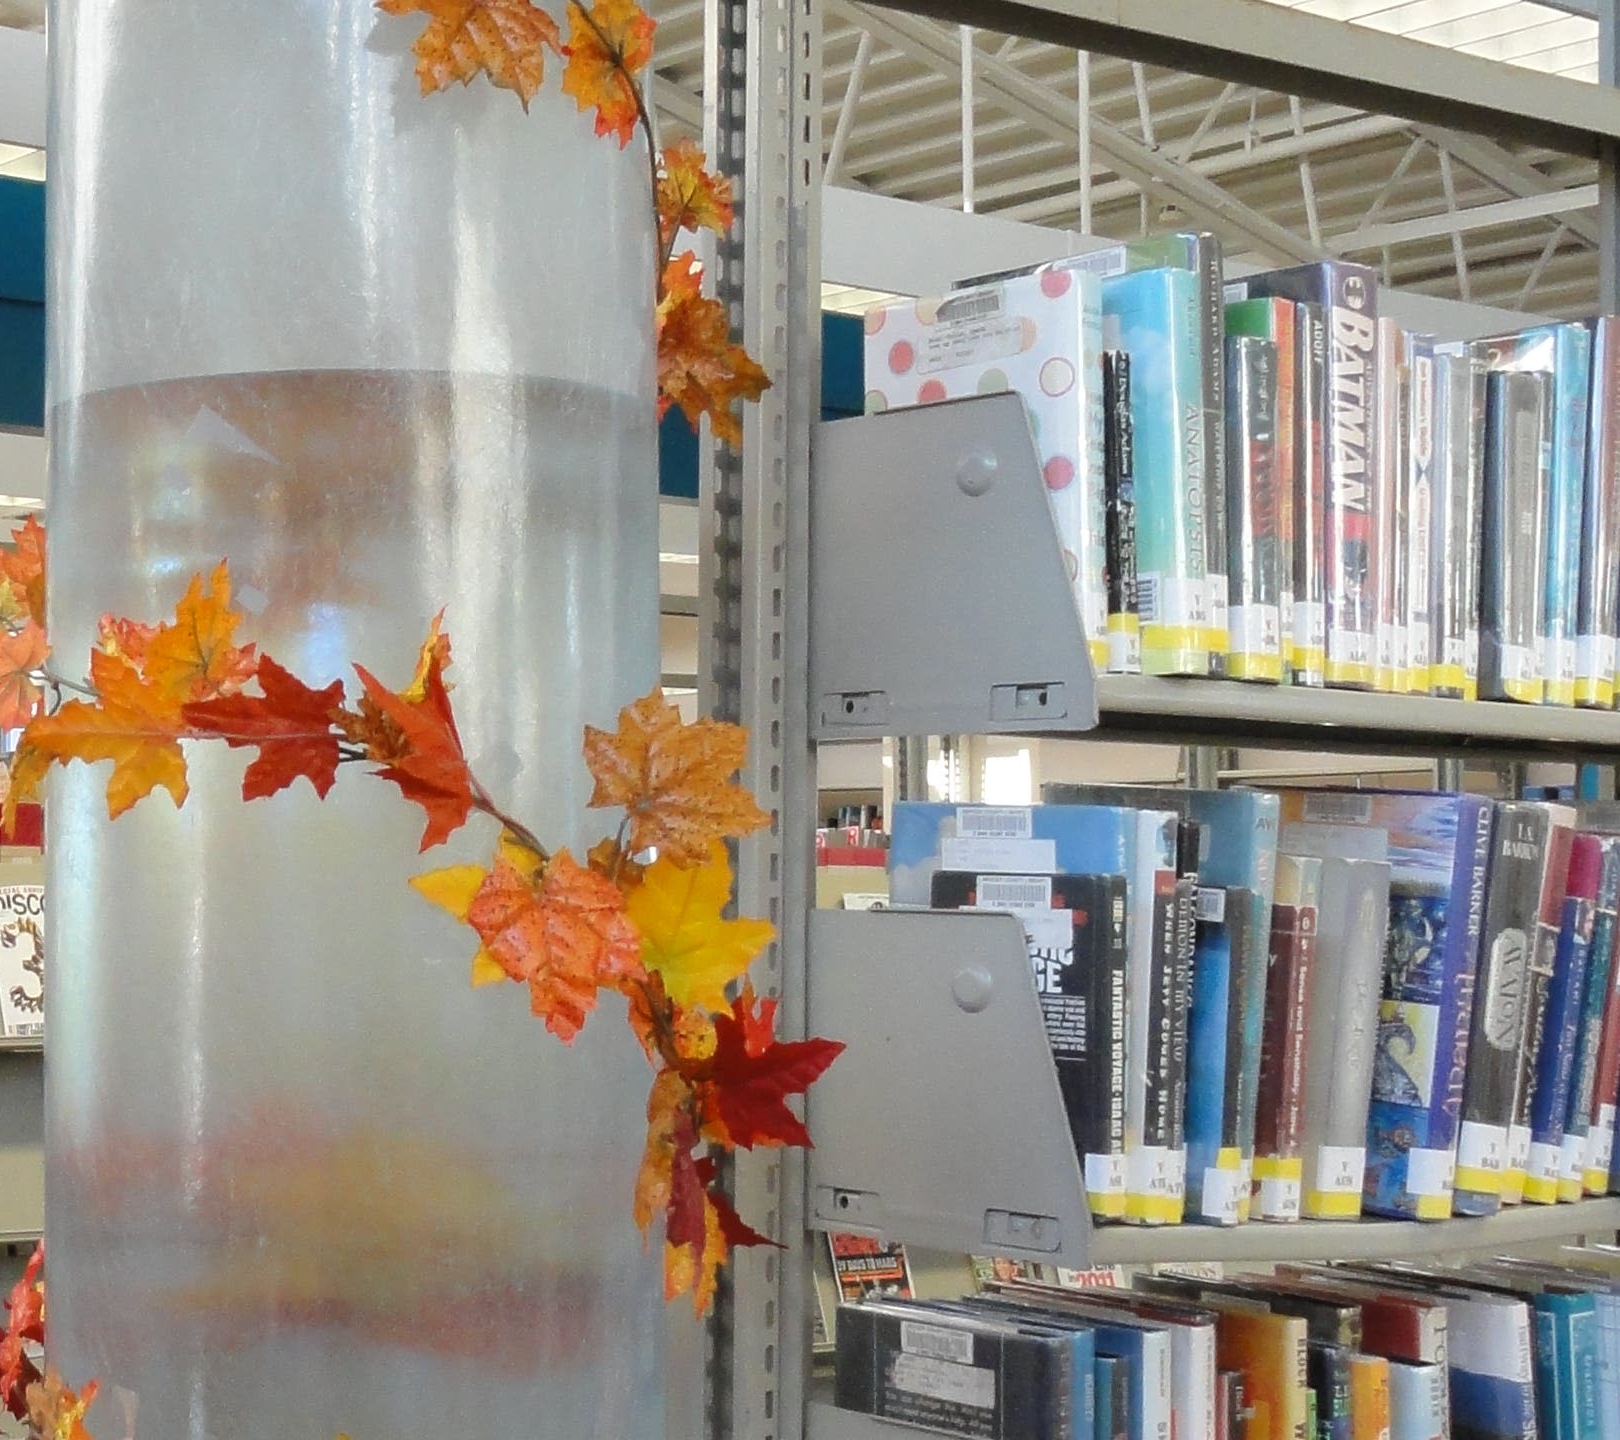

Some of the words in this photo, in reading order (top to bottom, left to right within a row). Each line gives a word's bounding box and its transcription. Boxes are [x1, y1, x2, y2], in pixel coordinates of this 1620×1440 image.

[1332, 307, 1375, 512] BATMAN
[1476, 806, 1489, 858] CLIVE
[1467, 866, 1485, 937] BARKER
[1112, 969, 1124, 1040] FANTASTIC
[1111, 1042, 1124, 1093] VOYAGE
